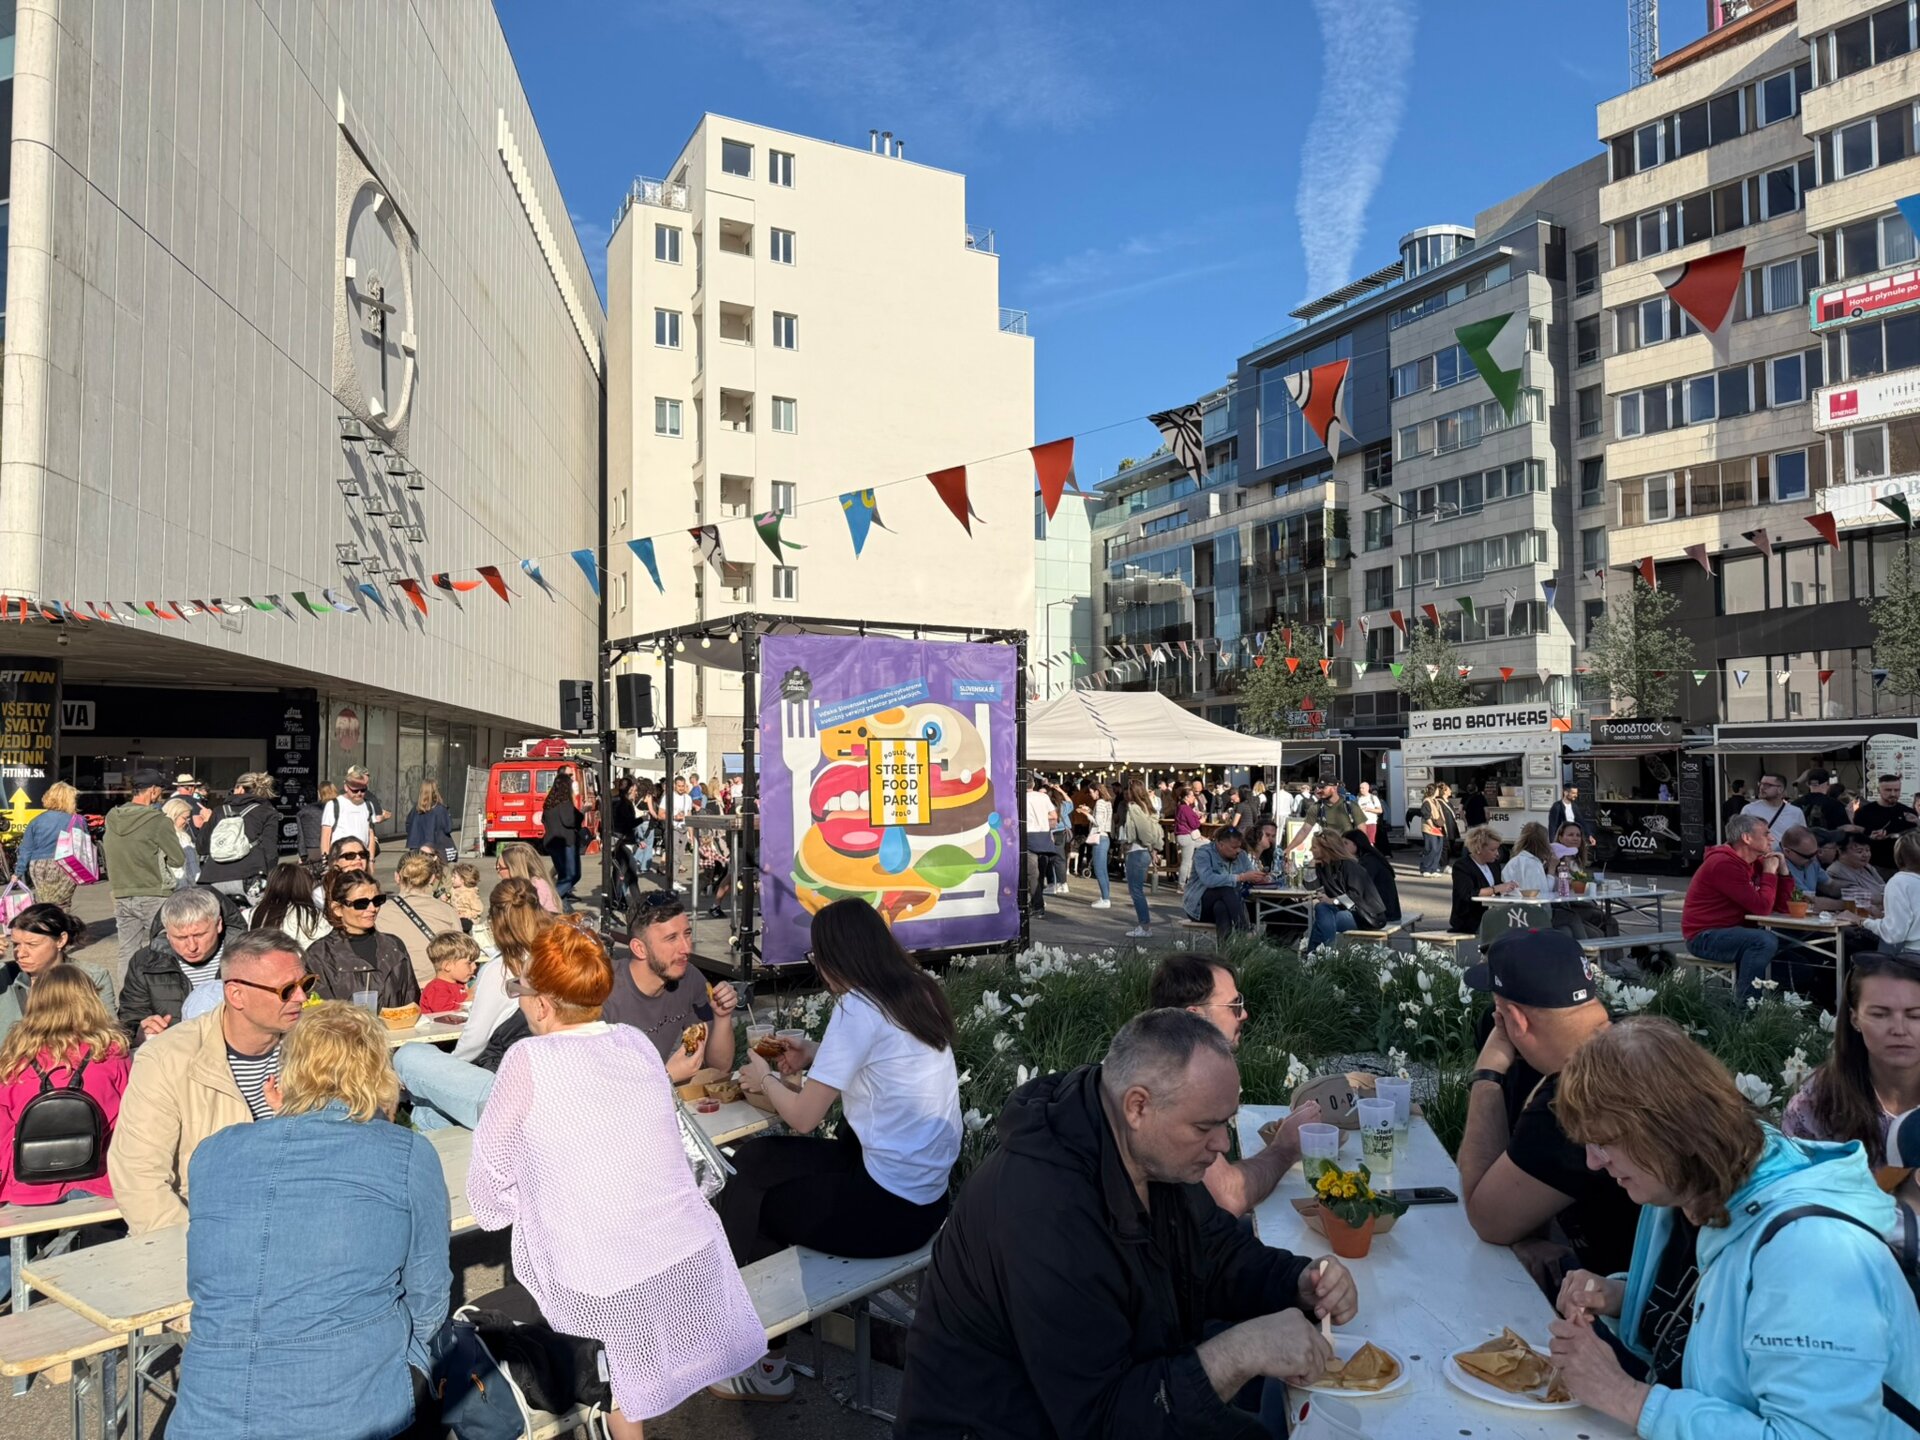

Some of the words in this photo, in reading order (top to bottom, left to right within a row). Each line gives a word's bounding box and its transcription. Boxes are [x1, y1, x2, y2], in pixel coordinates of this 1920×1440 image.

[1849, 295, 1873, 306] Hovor
[1875, 287, 1905, 301] plynule
[1907, 284, 1918, 293] po
[0, 670, 56, 684] FITINN
[1, 700, 51, 717] VŠETKY
[4, 718, 46, 733] SVALY
[1432, 716, 1462, 731] BAO
[1465, 710, 1548, 729] BROTHERS
[35, 734, 52, 749] DO
[0, 750, 48, 765] FITINN.
[2, 767, 45, 778] FITINN.SK
[281, 766, 310, 774] ACTION
[875, 764, 924, 775] STREET
[882, 779, 918, 790] FOOD
[883, 794, 918, 806] PARK
[891, 809, 912, 817] JEDLO
[1489, 813, 1510, 822] HERS
[1617, 830, 1658, 849] GYOZA
[1507, 907, 1529, 928] NY
